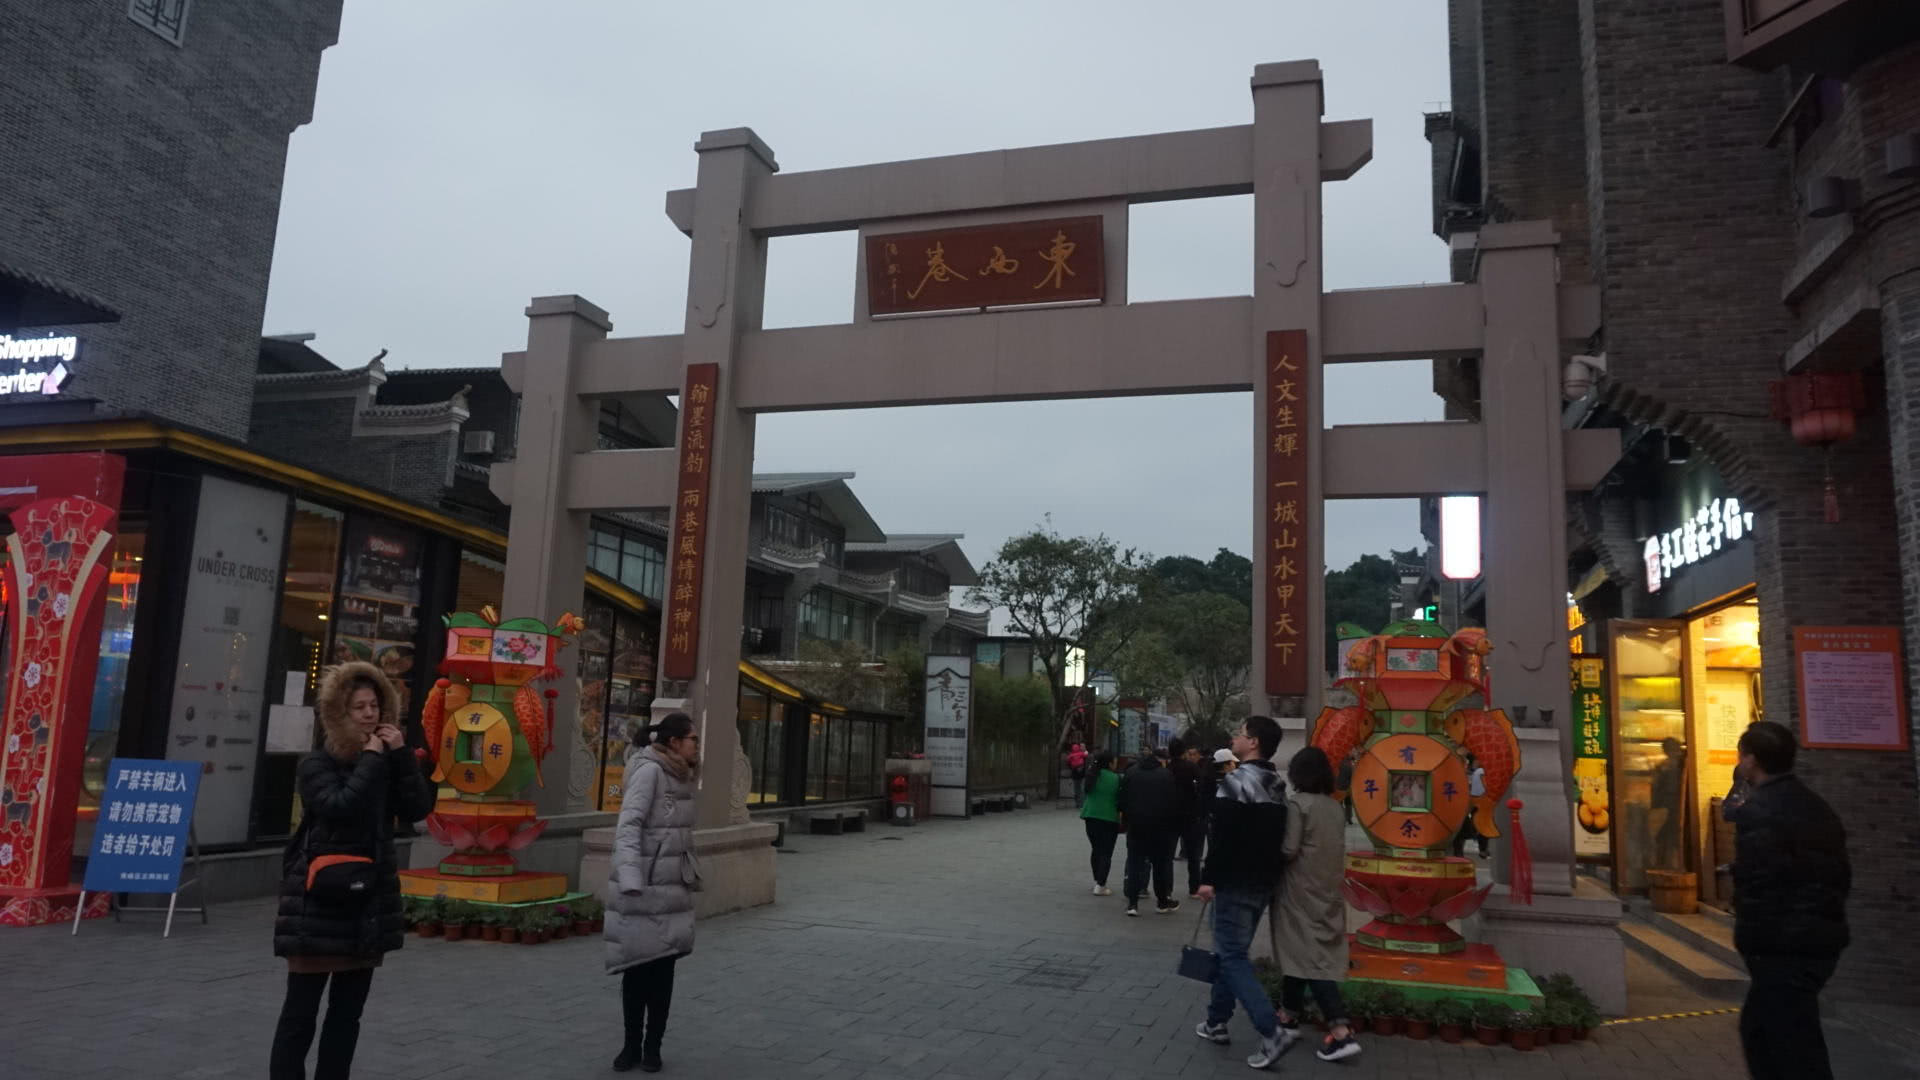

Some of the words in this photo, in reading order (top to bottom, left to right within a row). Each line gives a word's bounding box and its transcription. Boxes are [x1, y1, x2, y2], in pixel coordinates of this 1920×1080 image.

[1273, 355, 1300, 457] 人文生輝
[197, 557, 236, 577] UNDER
[239, 564, 275, 585] CROSS
[1273, 481, 1300, 665] 一城山水甲天下
[468, 712, 485, 726] 有
[488, 743, 504, 759] 年
[1399, 745, 1419, 765] 有
[115, 769, 187, 792] 严禁车辆进入
[1363, 779, 1379, 800] 年
[1440, 781, 1458, 802] 年
[108, 800, 182, 825] 请勿携带宠物
[1399, 819, 1421, 839] 余
